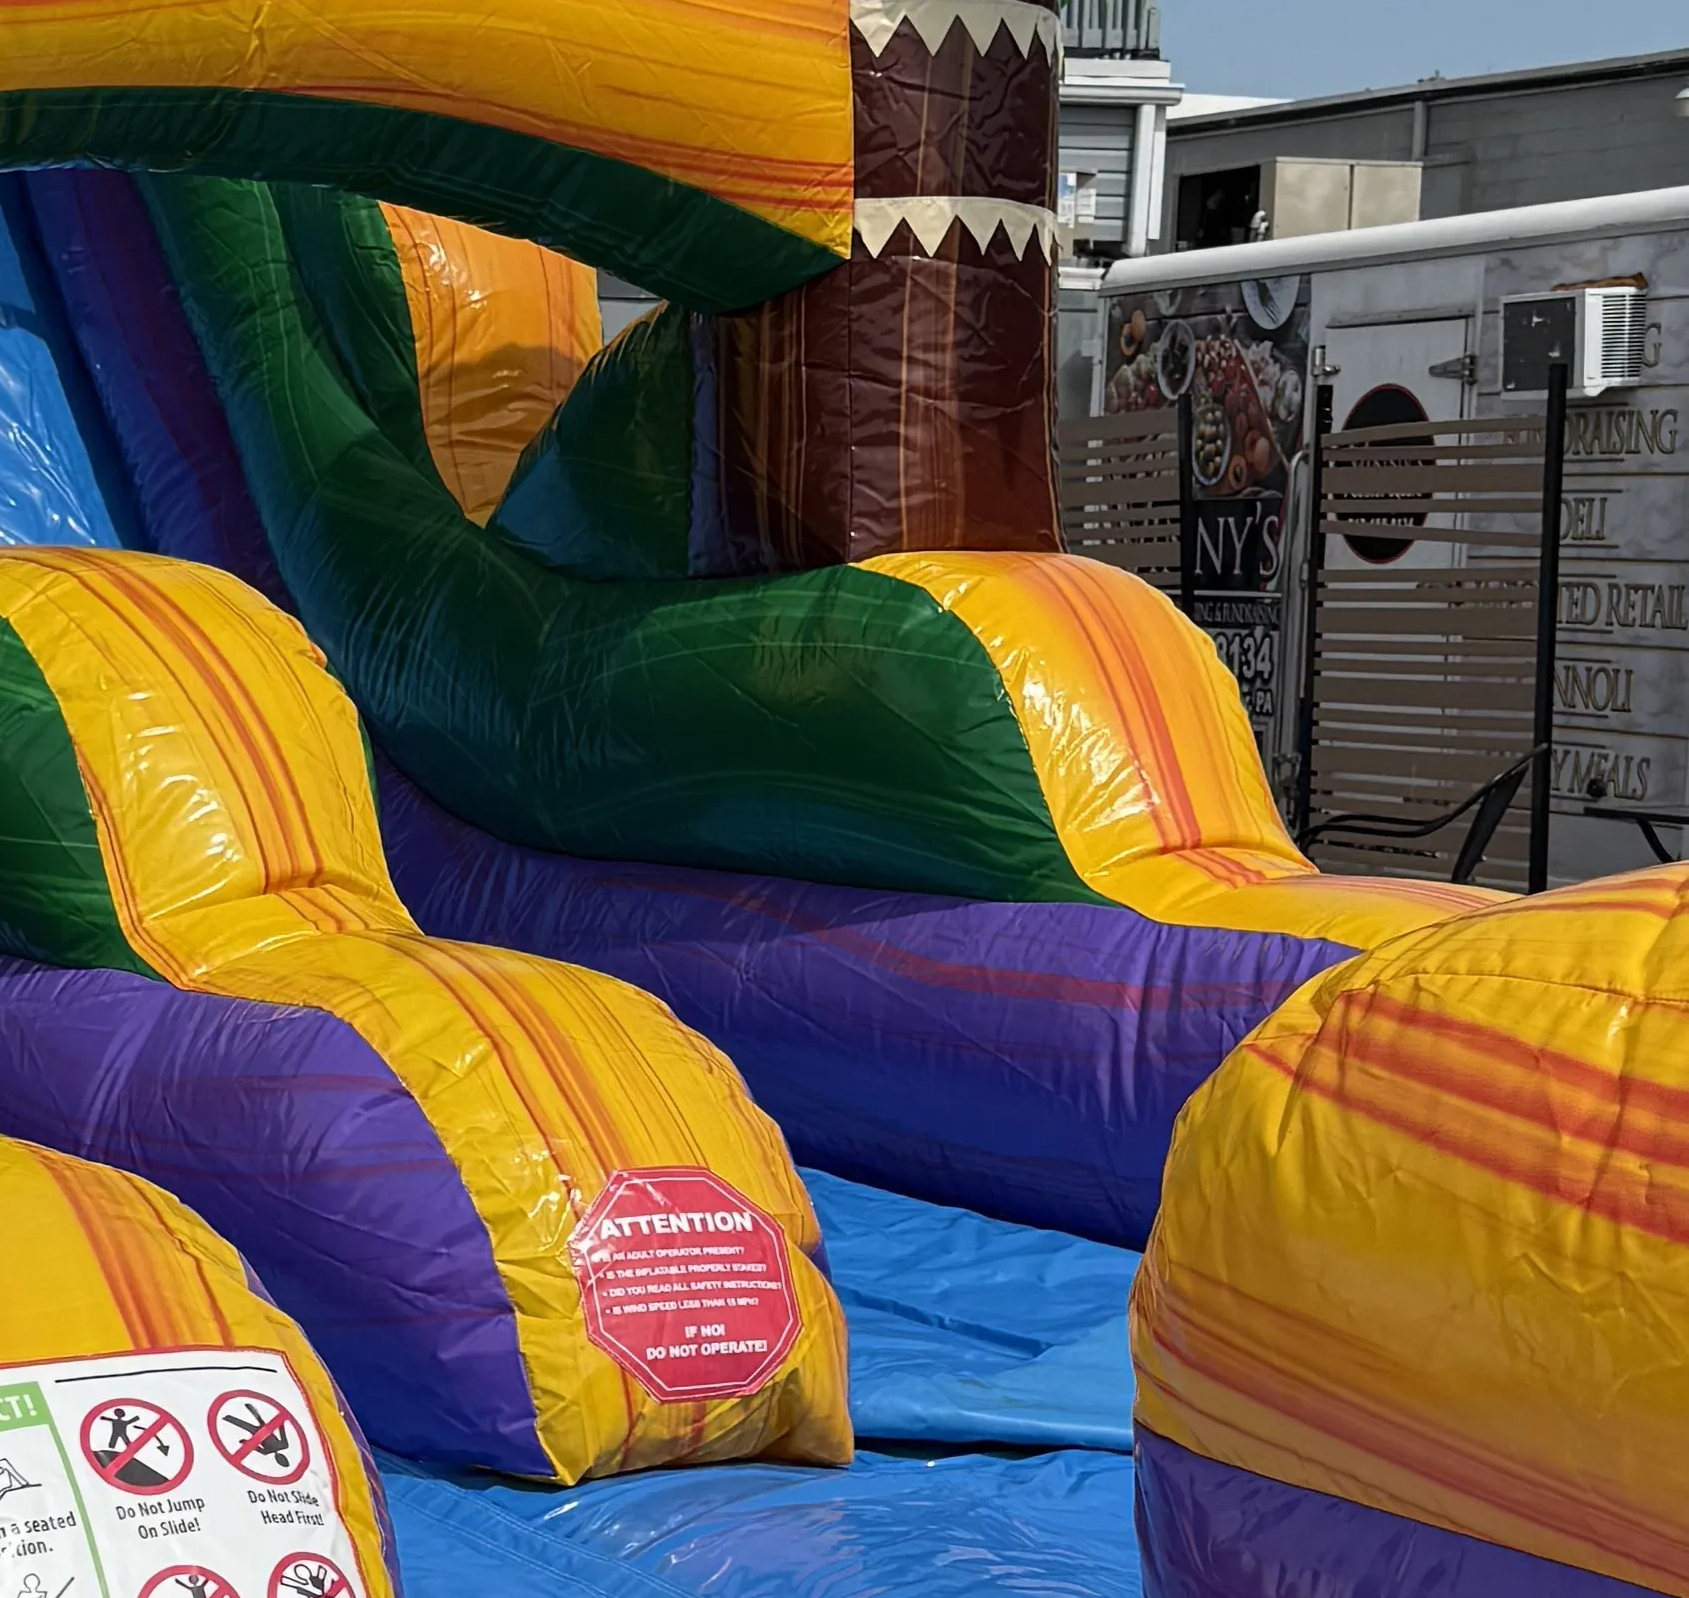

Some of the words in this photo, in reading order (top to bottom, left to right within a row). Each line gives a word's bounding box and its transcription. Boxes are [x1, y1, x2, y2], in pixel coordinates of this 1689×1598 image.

[600, 1210, 753, 1240] ATTENTION
[684, 1325, 697, 1338] IF
[700, 1323, 725, 1337] NO!
[645, 1346, 667, 1360] DO
[668, 1344, 698, 1358] NOT
[246, 1490, 266, 1503] Do
[266, 1489, 291, 1503] Not
[115, 1505, 136, 1520] Do
[137, 1501, 165, 1517] Not
[166, 1498, 205, 1513] Jump
[260, 1510, 294, 1524] Head
[294, 1511, 324, 1526] First!
[24, 1511, 76, 1533] seated
[137, 1524, 158, 1539] On
[159, 1517, 201, 1536] Slide!
